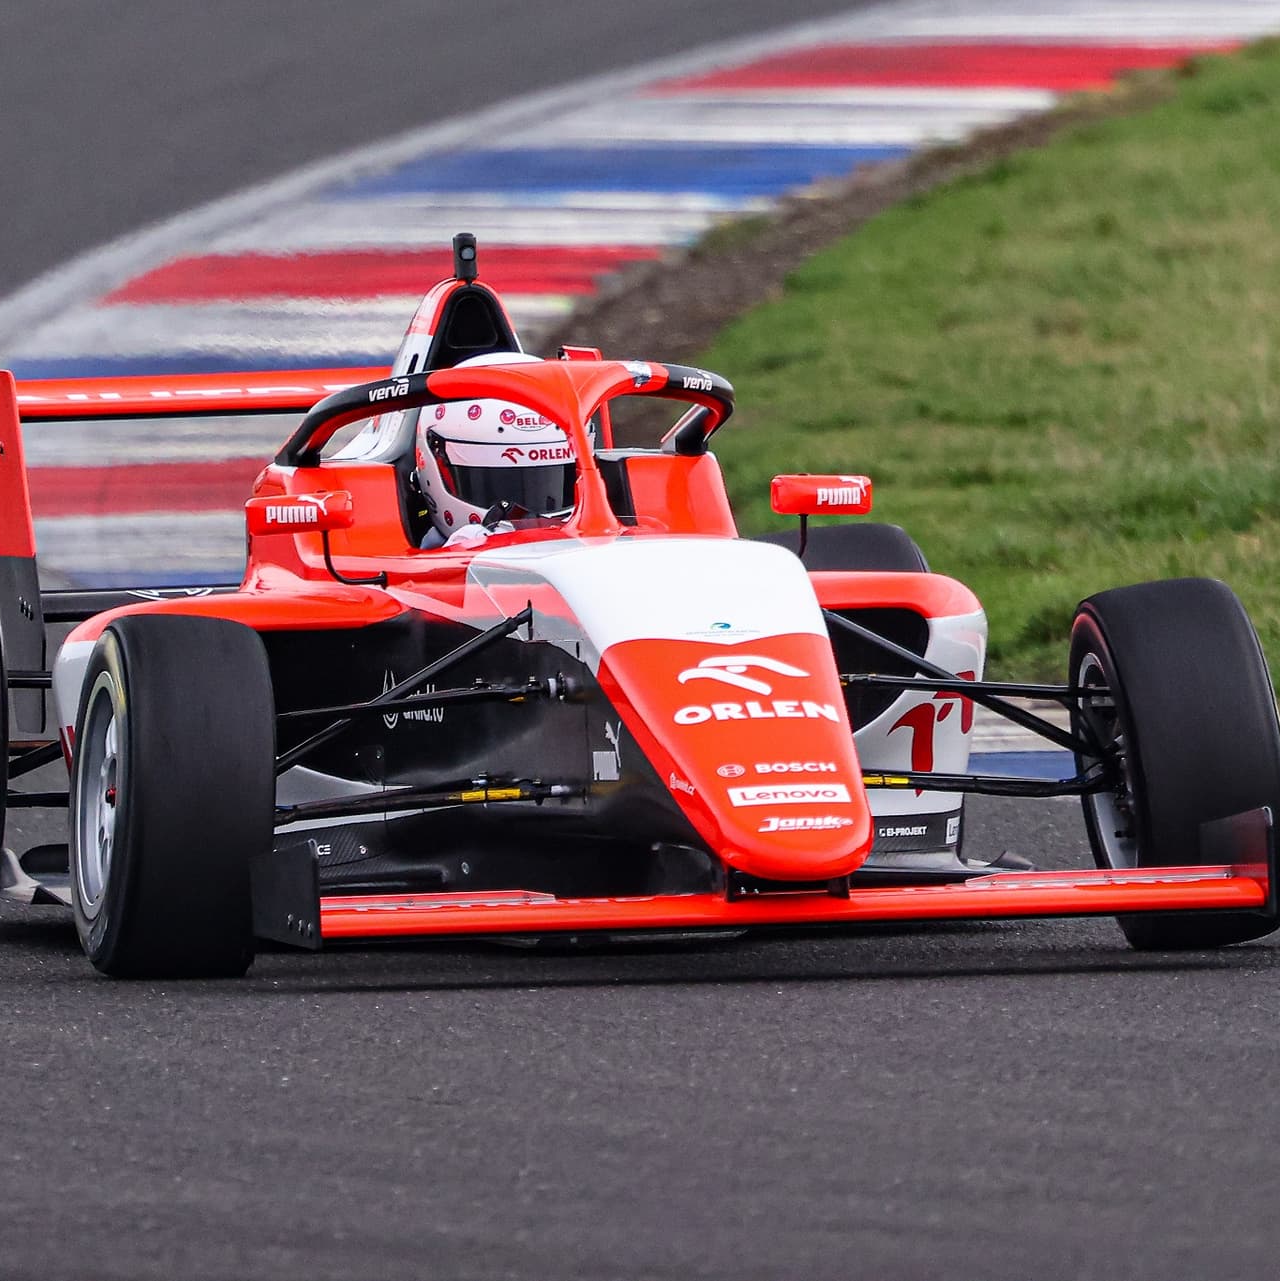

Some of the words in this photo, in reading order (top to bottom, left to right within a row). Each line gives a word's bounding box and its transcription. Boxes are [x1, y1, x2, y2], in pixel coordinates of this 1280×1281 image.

[368, 377, 409, 402] verva
[682, 376, 712, 391] verva
[528, 448, 570, 461] ORLEN
[817, 487, 860, 505] PUMA
[266, 506, 317, 523] PUMA
[674, 700, 841, 725] ORLEN
[754, 762, 837, 773] BOSCH
[740, 790, 837, 801] Lenovo
